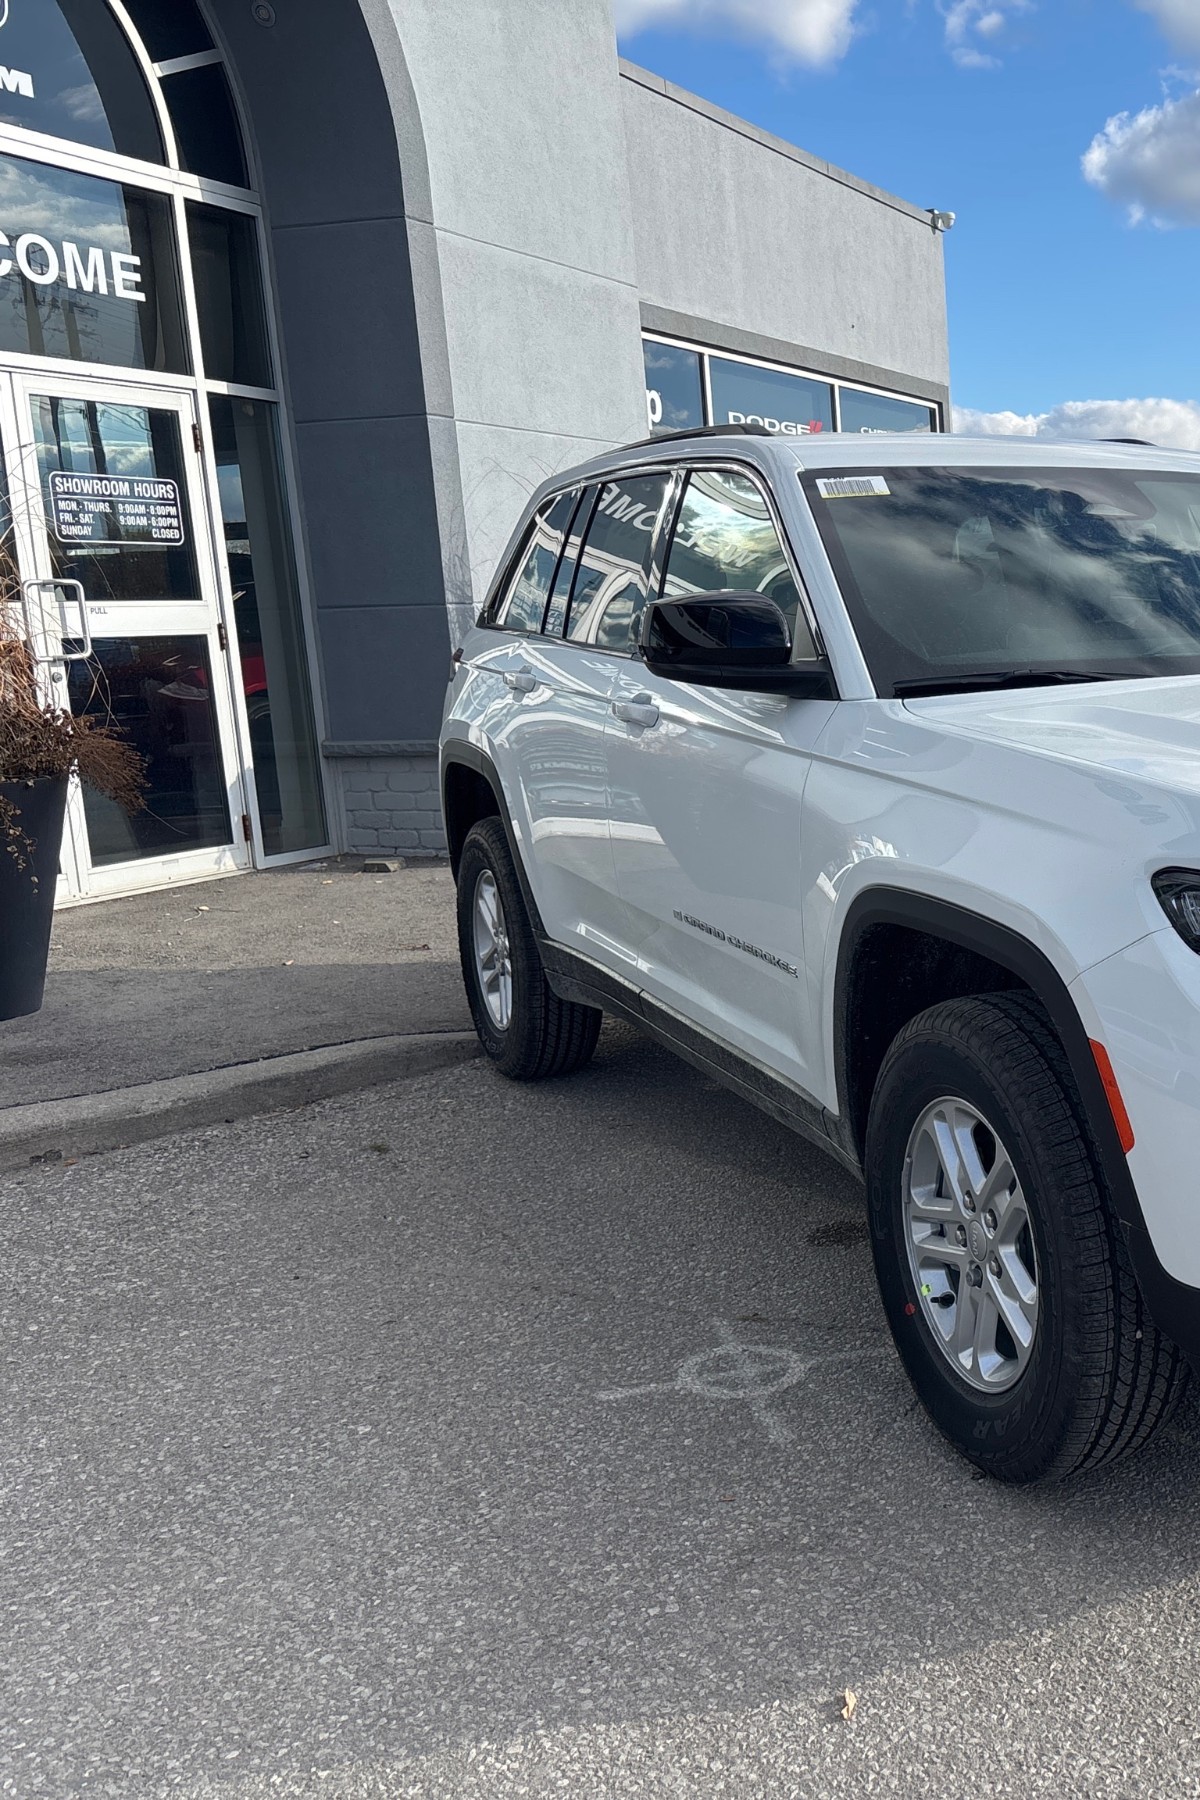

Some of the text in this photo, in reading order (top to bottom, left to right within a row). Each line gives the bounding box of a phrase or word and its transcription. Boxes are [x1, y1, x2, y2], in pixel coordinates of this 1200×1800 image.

[55, 477, 175, 499] SHOWROOM HOURS
[61, 525, 180, 539] SUNDAY CLOSED
[90, 607, 108, 615] PULL
